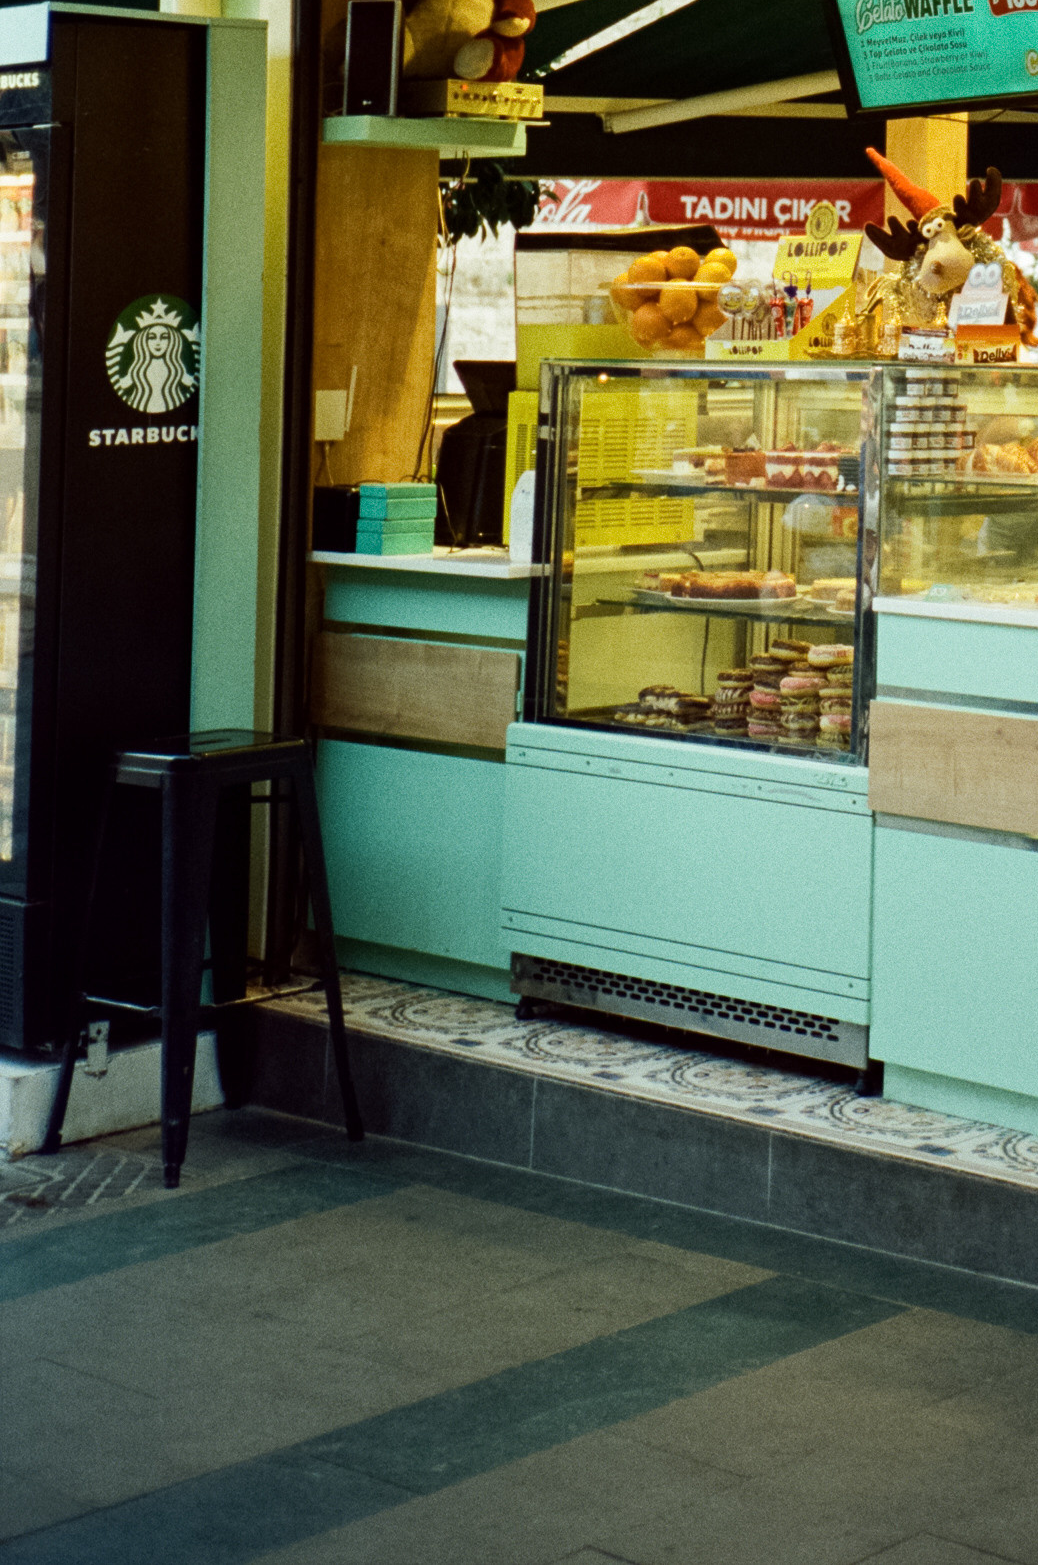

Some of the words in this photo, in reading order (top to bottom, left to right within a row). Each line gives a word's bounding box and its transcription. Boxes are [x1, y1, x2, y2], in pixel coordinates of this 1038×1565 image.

[680, 195, 768, 220] TADINI
[773, 197, 852, 226] ÇIKR
[787, 241, 849, 258] LOLLIPOP
[89, 425, 199, 447] STARBUC
